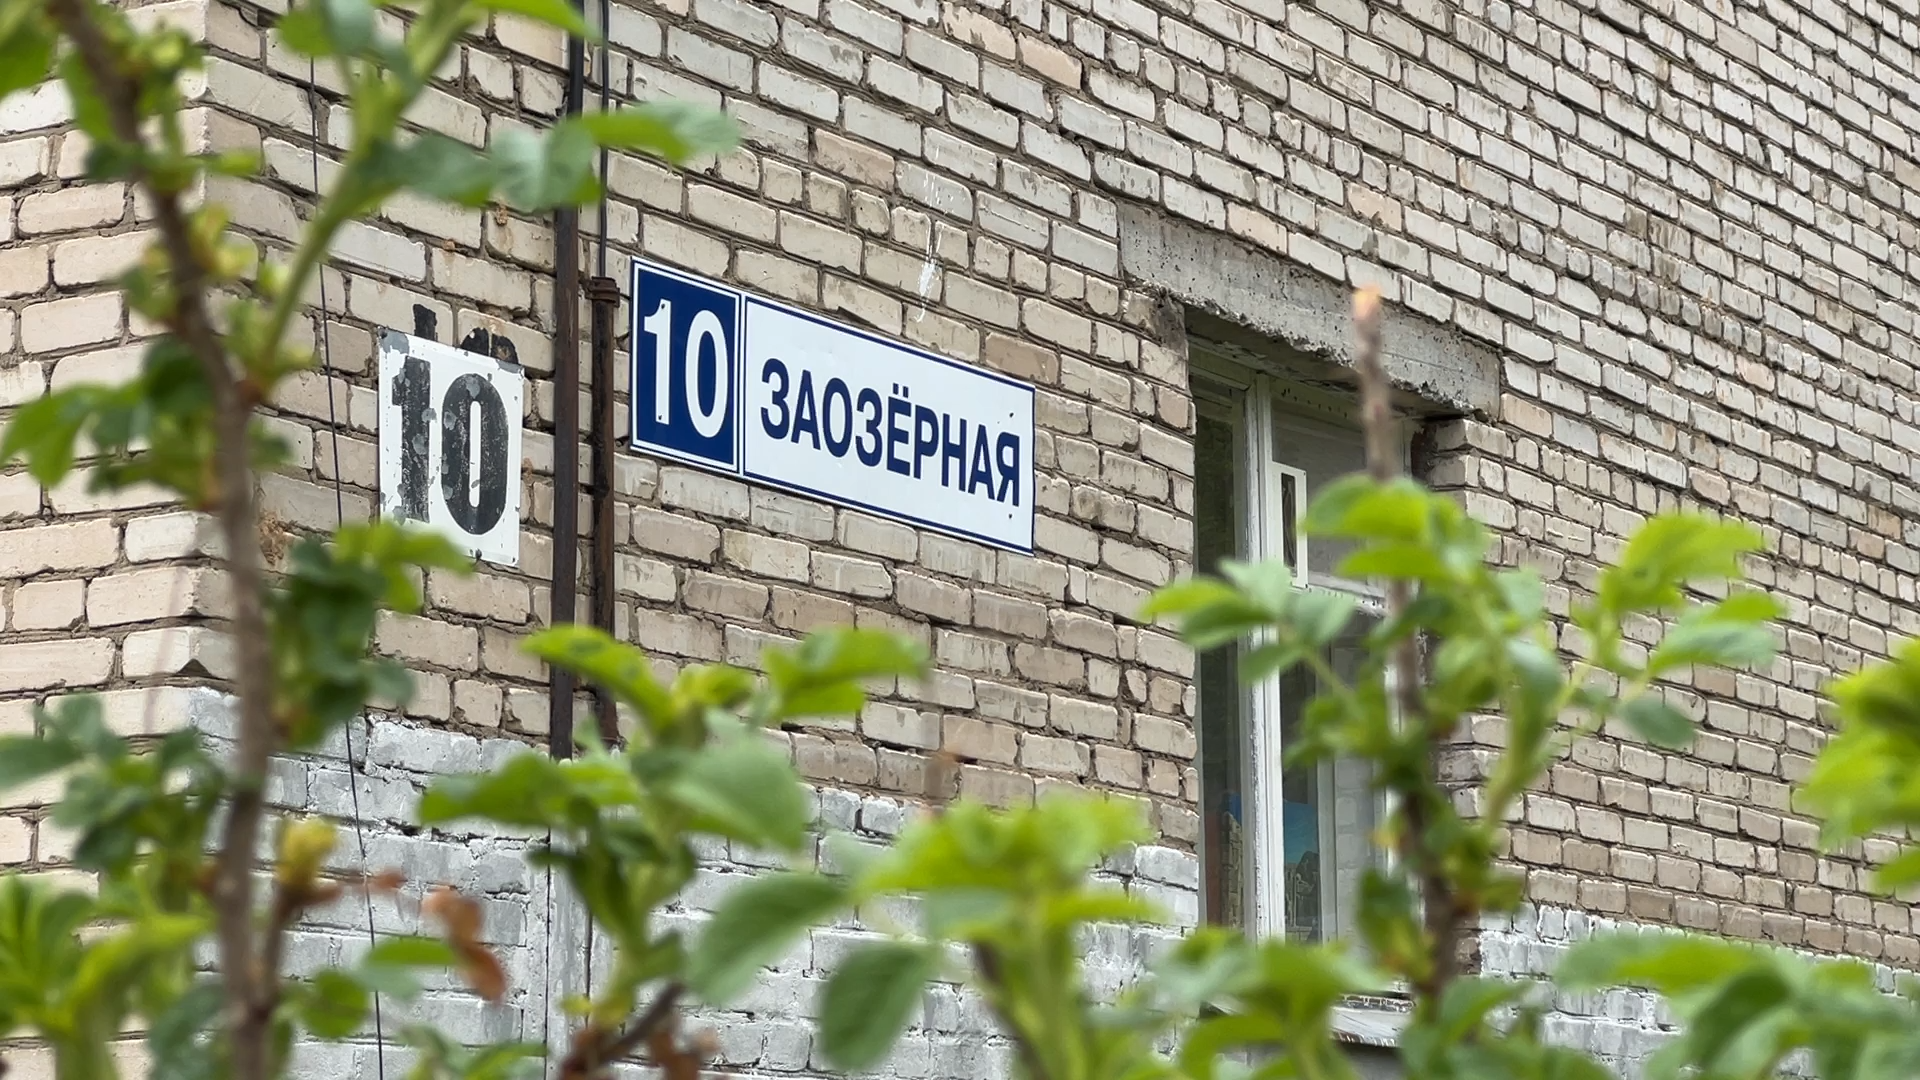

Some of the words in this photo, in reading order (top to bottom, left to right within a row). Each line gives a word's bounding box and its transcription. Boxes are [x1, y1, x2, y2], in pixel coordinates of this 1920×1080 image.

[643, 298, 729, 438] 10
[760, 357, 1021, 507] ЗАОЗЁРНАЯ
[391, 355, 509, 535] 10
